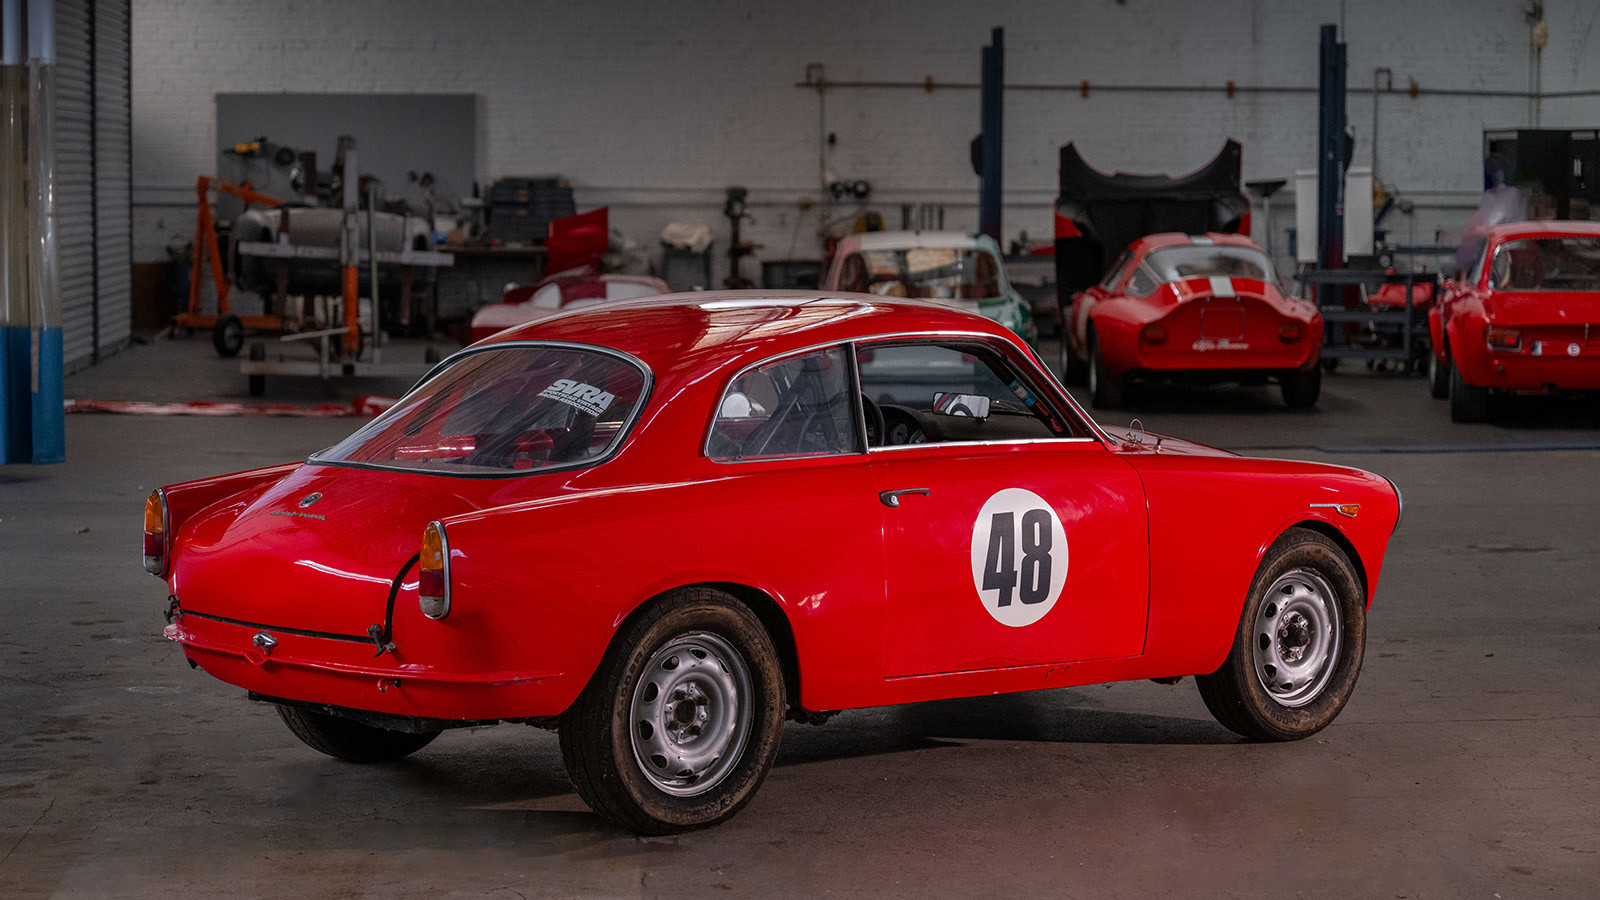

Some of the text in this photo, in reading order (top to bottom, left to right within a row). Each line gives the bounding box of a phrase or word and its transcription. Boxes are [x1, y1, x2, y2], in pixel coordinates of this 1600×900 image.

[546, 379, 615, 410] SVRA
[577, 398, 604, 414] VINTAGE
[982, 508, 1052, 607] 48
